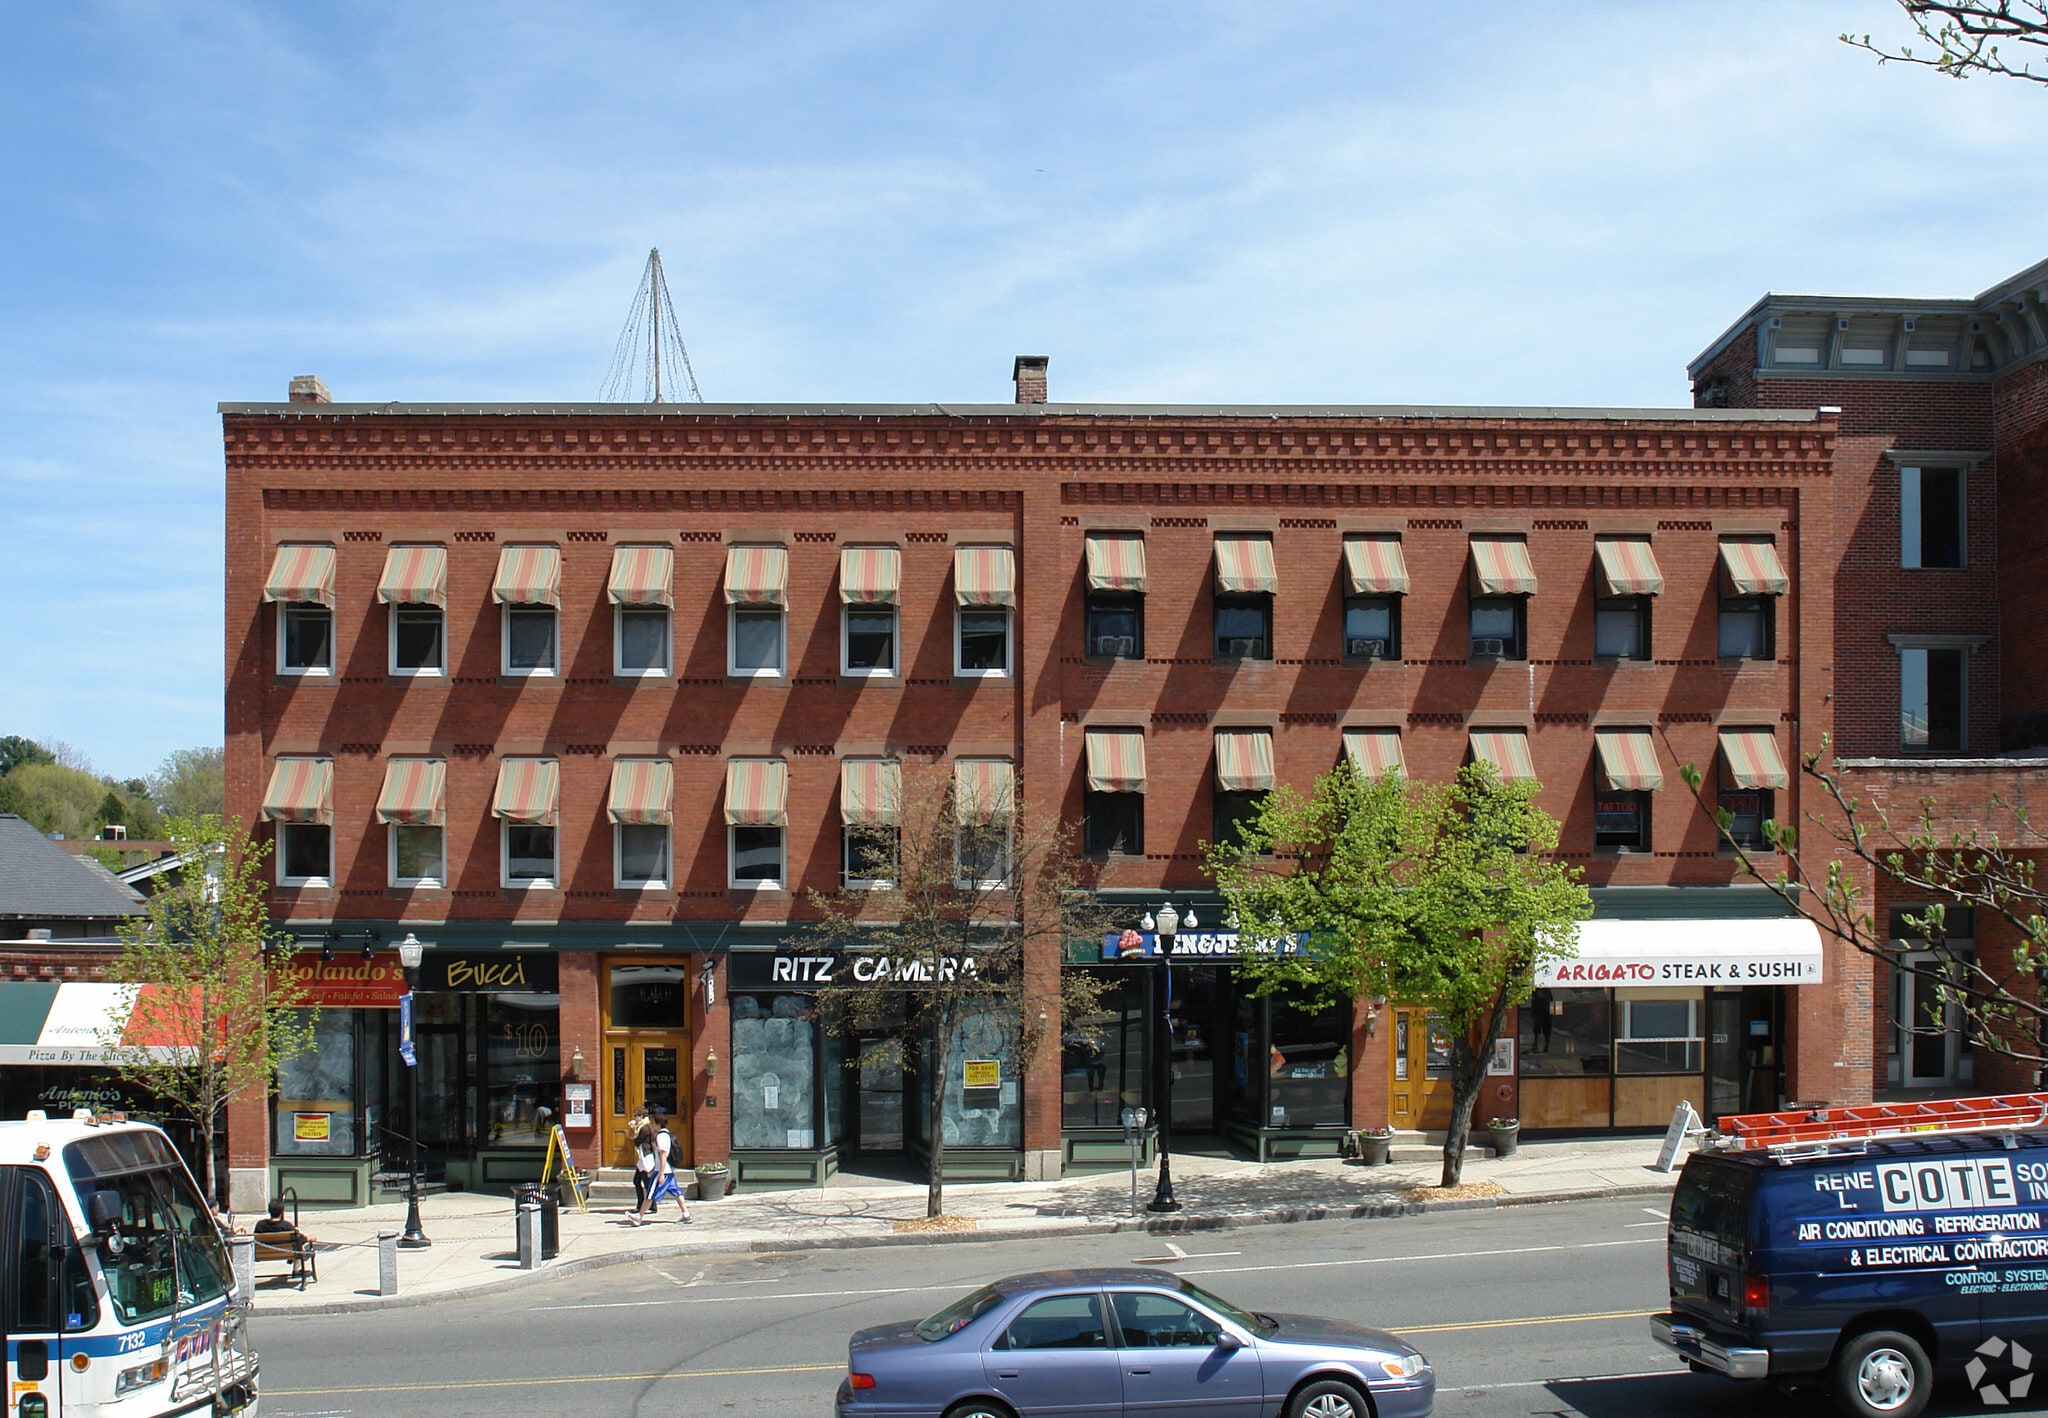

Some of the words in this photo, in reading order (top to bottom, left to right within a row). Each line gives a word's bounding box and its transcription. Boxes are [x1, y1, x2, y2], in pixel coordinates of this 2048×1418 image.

[1598, 802, 1638, 811] TATTOO
[772, 957, 835, 982] RITZ
[853, 957, 979, 982] CAMERA
[1556, 963, 1655, 981] ARIGATO
[1662, 963, 1722, 979] STEAK
[1728, 963, 1741, 978] &
[1747, 962, 1801, 978] SUSHI
[332, 991, 363, 1001] Falafel
[28, 1050, 56, 1061] Pizza
[62, 1050, 75, 1063] By
[79, 1050, 98, 1061] The
[1814, 1171, 1874, 1192] RENE
[1880, 1164, 2014, 1205] COTE
[2016, 1162, 2048, 1182] SO
[1838, 1191, 1858, 1209] L.
[1798, 1223, 1822, 1241] AIR
[1825, 1217, 1925, 1239] CONDITIONING
[1934, 1212, 2041, 1234] REFRIGERATION
[1850, 1250, 1862, 1266] &
[1866, 1245, 1950, 1265] ELECTRICAL
[1945, 1271, 2001, 1286] CONTROL
[1960, 1284, 1997, 1295] ELECTRIC
[118, 1331, 146, 1352] 7132
